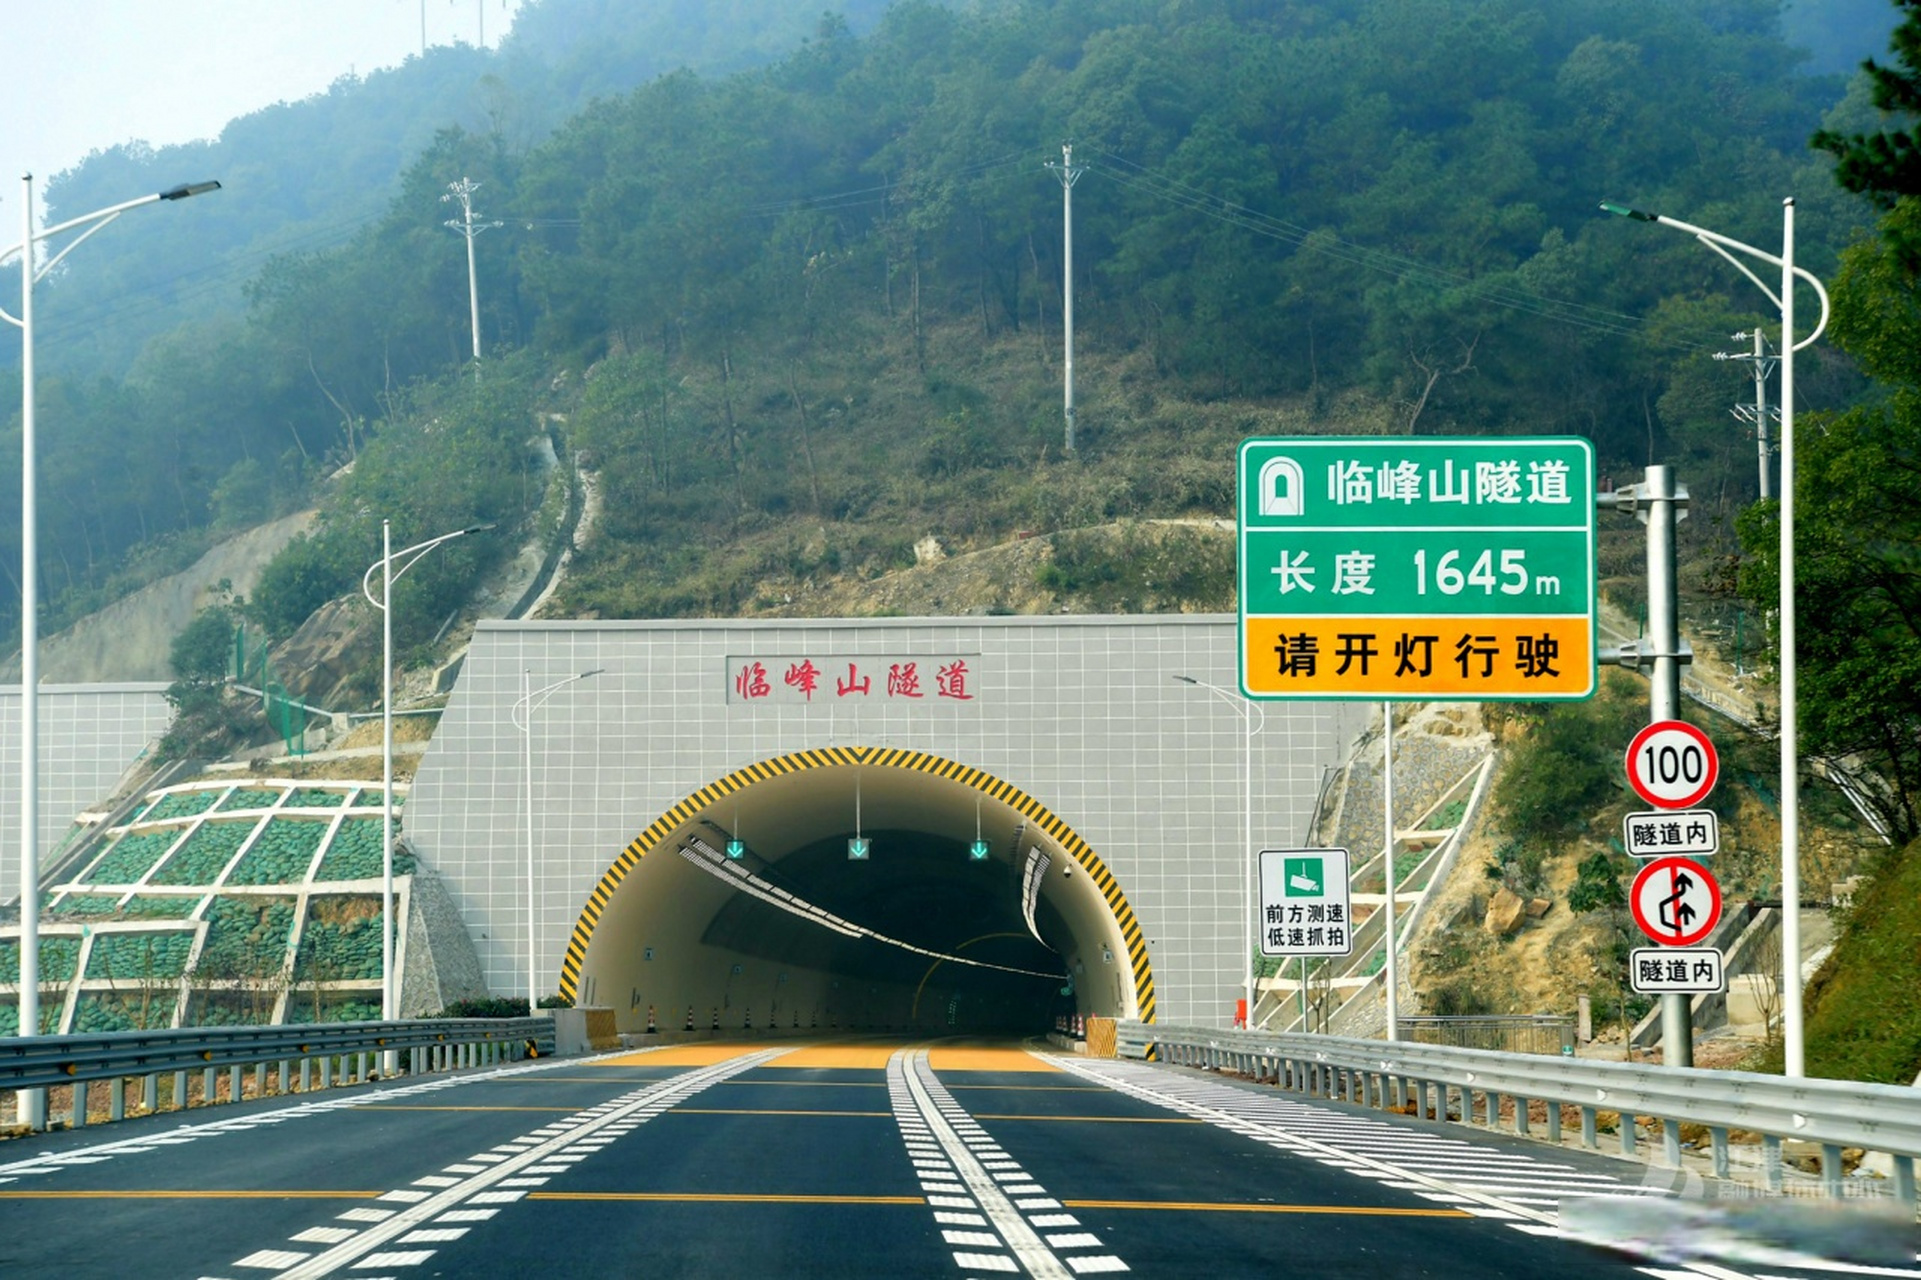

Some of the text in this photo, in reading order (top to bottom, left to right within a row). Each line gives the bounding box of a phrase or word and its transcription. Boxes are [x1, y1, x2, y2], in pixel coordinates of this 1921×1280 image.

[1327, 459, 1572, 505] 临峰山隧道
[1270, 549, 1560, 595] 长度 1645m
[1274, 633, 1560, 678] 请开灯行驶
[735, 659, 974, 701] 临峰山隧道
[1645, 745, 1702, 784] 100
[1633, 821, 1707, 846] 隧道内
[1266, 904, 1344, 924] 前方测速
[1268, 927, 1344, 947] 低速抓拍
[1639, 960, 1713, 983] 隧道内
